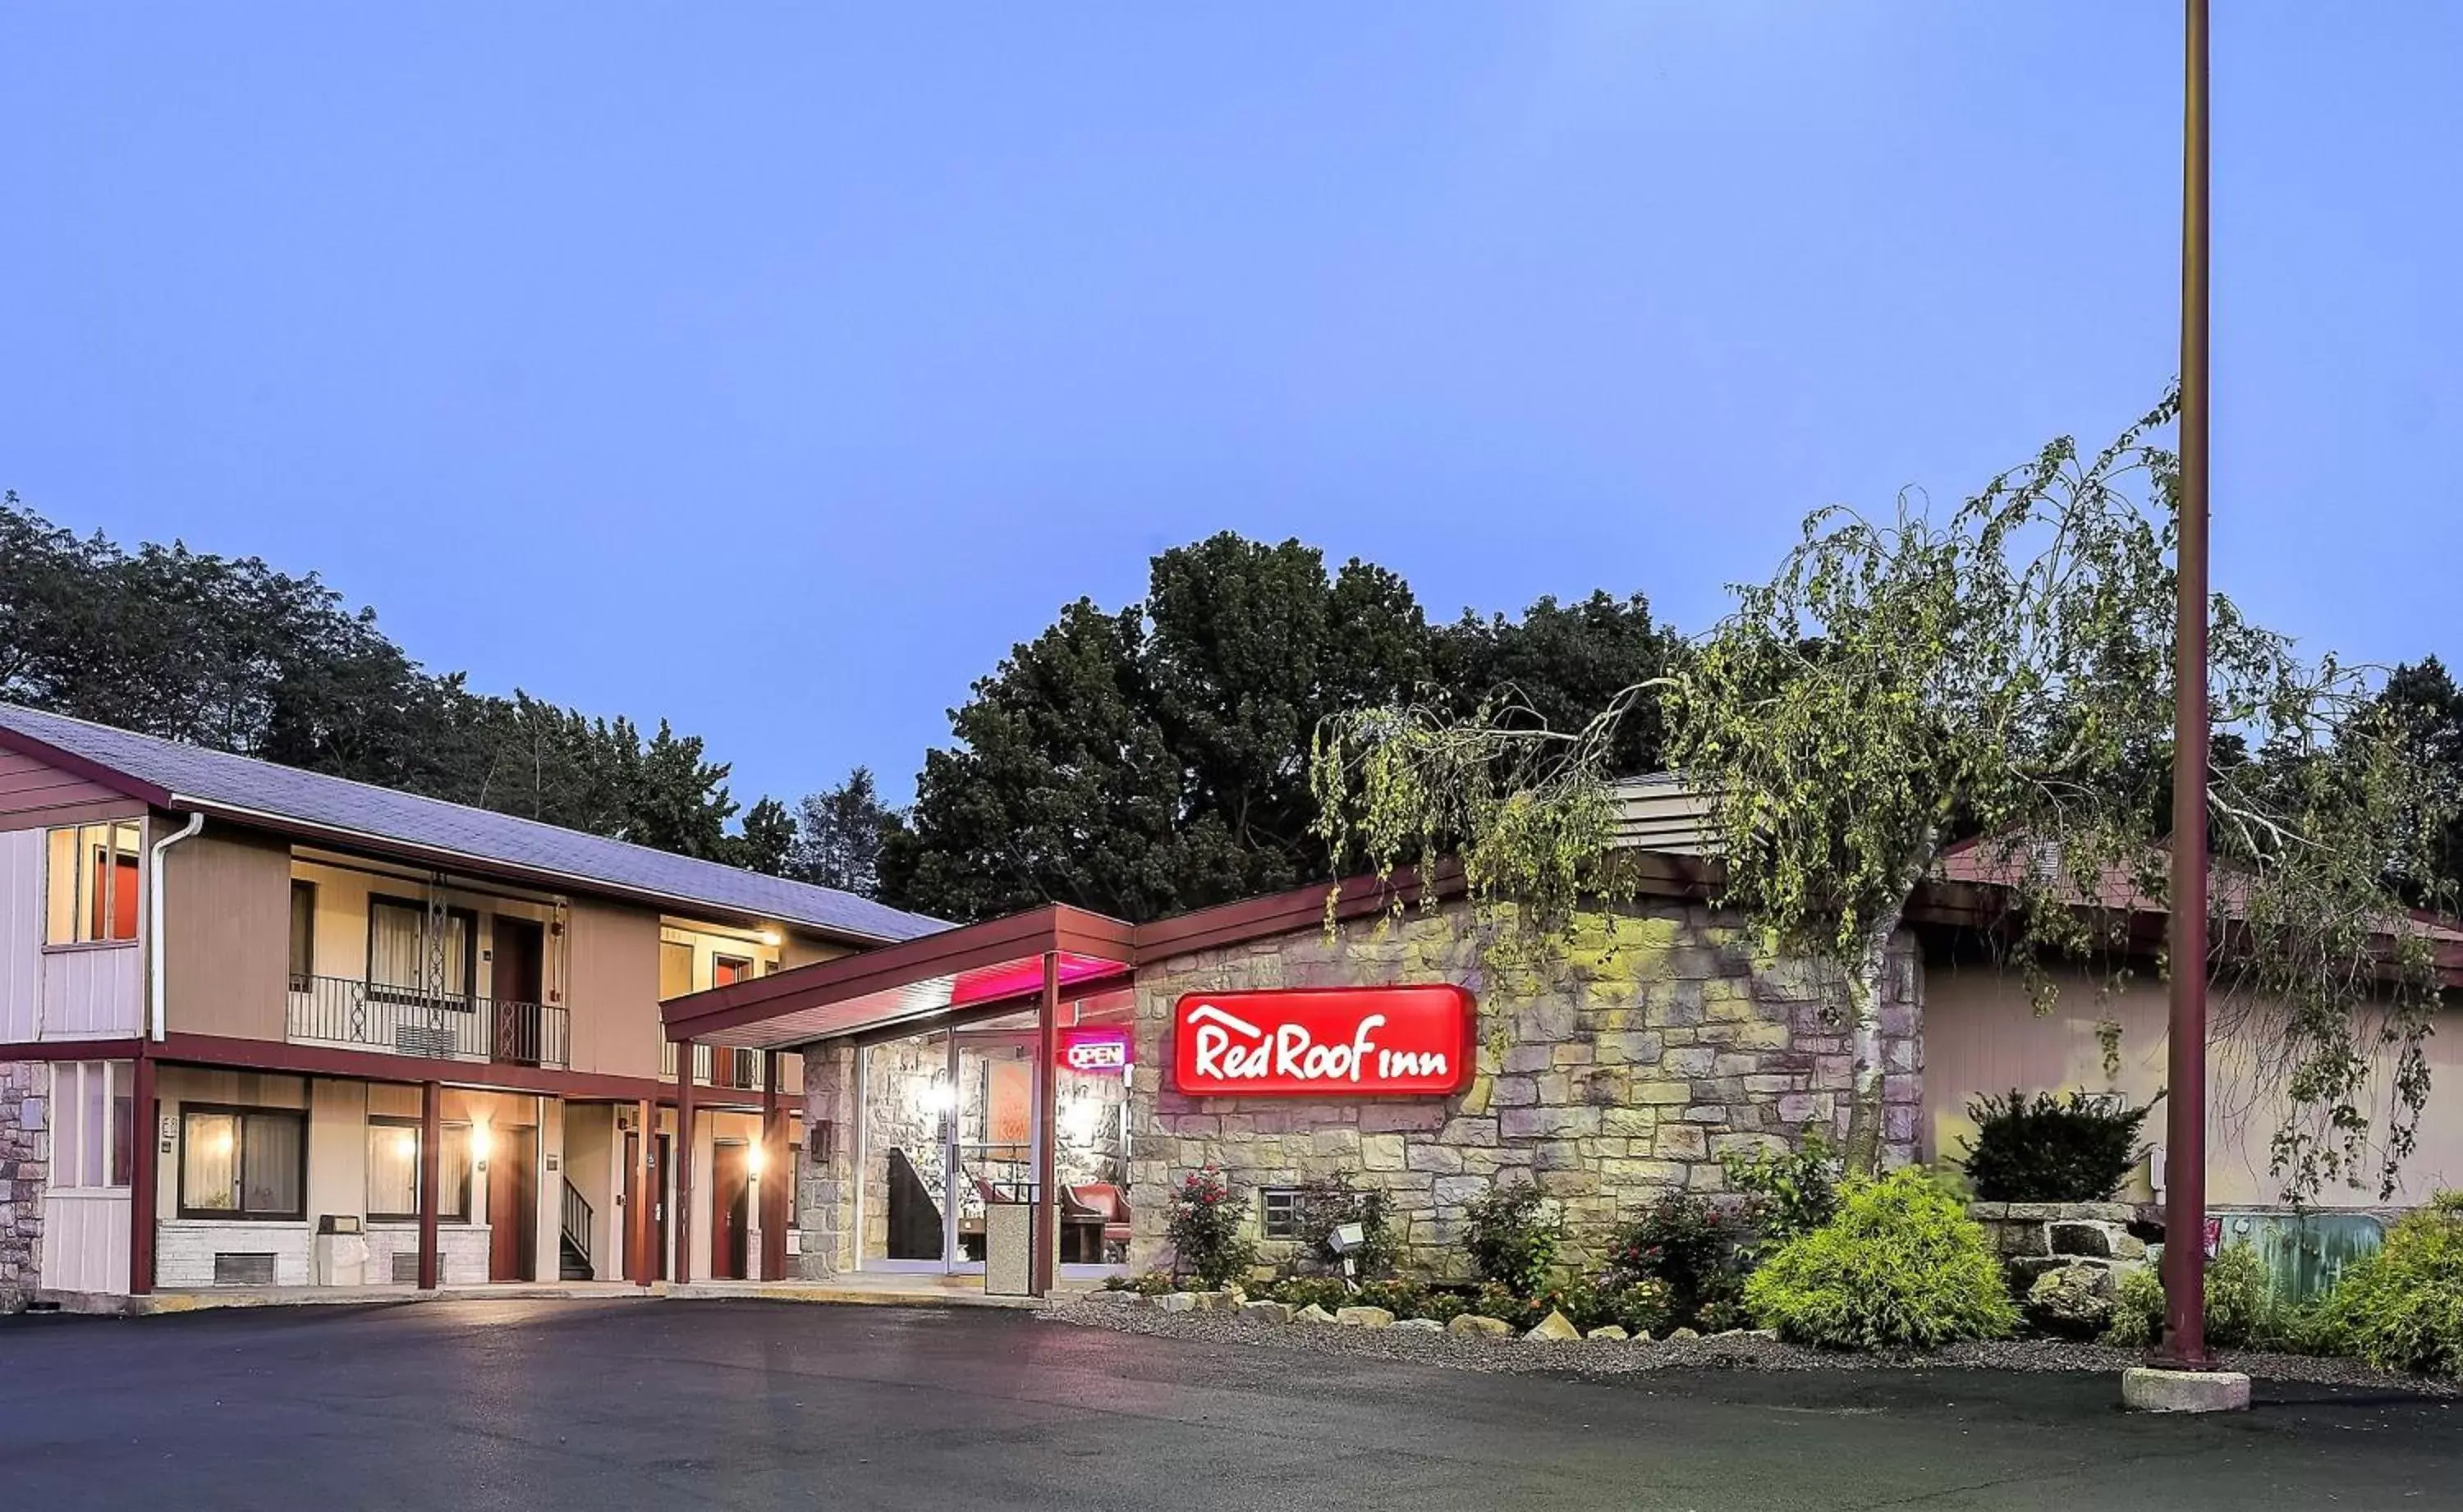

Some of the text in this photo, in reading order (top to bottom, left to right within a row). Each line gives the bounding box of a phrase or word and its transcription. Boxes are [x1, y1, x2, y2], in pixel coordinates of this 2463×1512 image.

[1069, 1044, 1122, 1066] OPEN
[1196, 1024, 1273, 1080] Red
[1276, 1014, 1386, 1083] Roof
